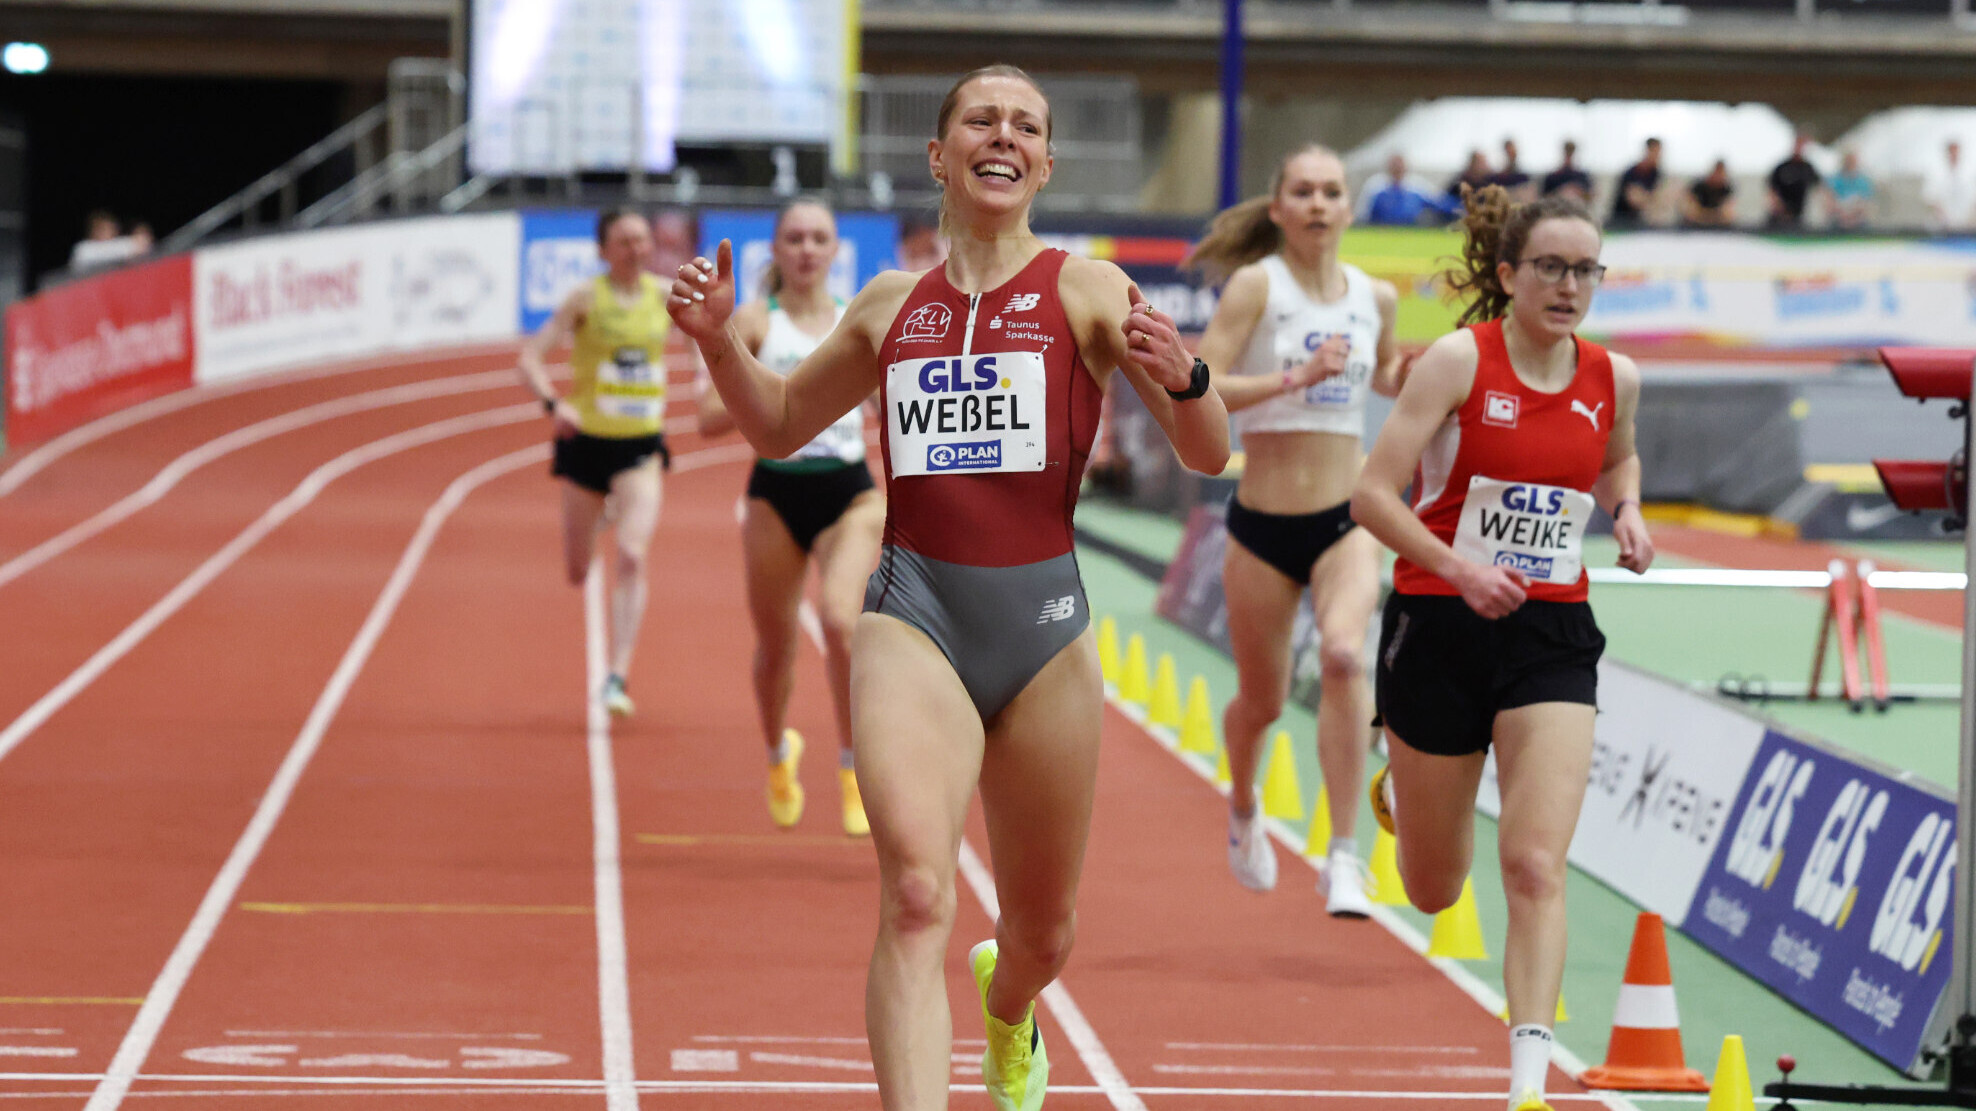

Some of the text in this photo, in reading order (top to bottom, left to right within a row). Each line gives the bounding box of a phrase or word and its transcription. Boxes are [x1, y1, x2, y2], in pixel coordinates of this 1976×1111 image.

[1006, 321, 1040, 330] Taunus
[1005, 330, 1055, 344] Sparkasse
[958, 445, 999, 460] PLAN
[958, 459, 999, 467] INTERNATIONAL
[1480, 508, 1572, 549] WEIKE
[1519, 556, 1551, 572] PLAN
